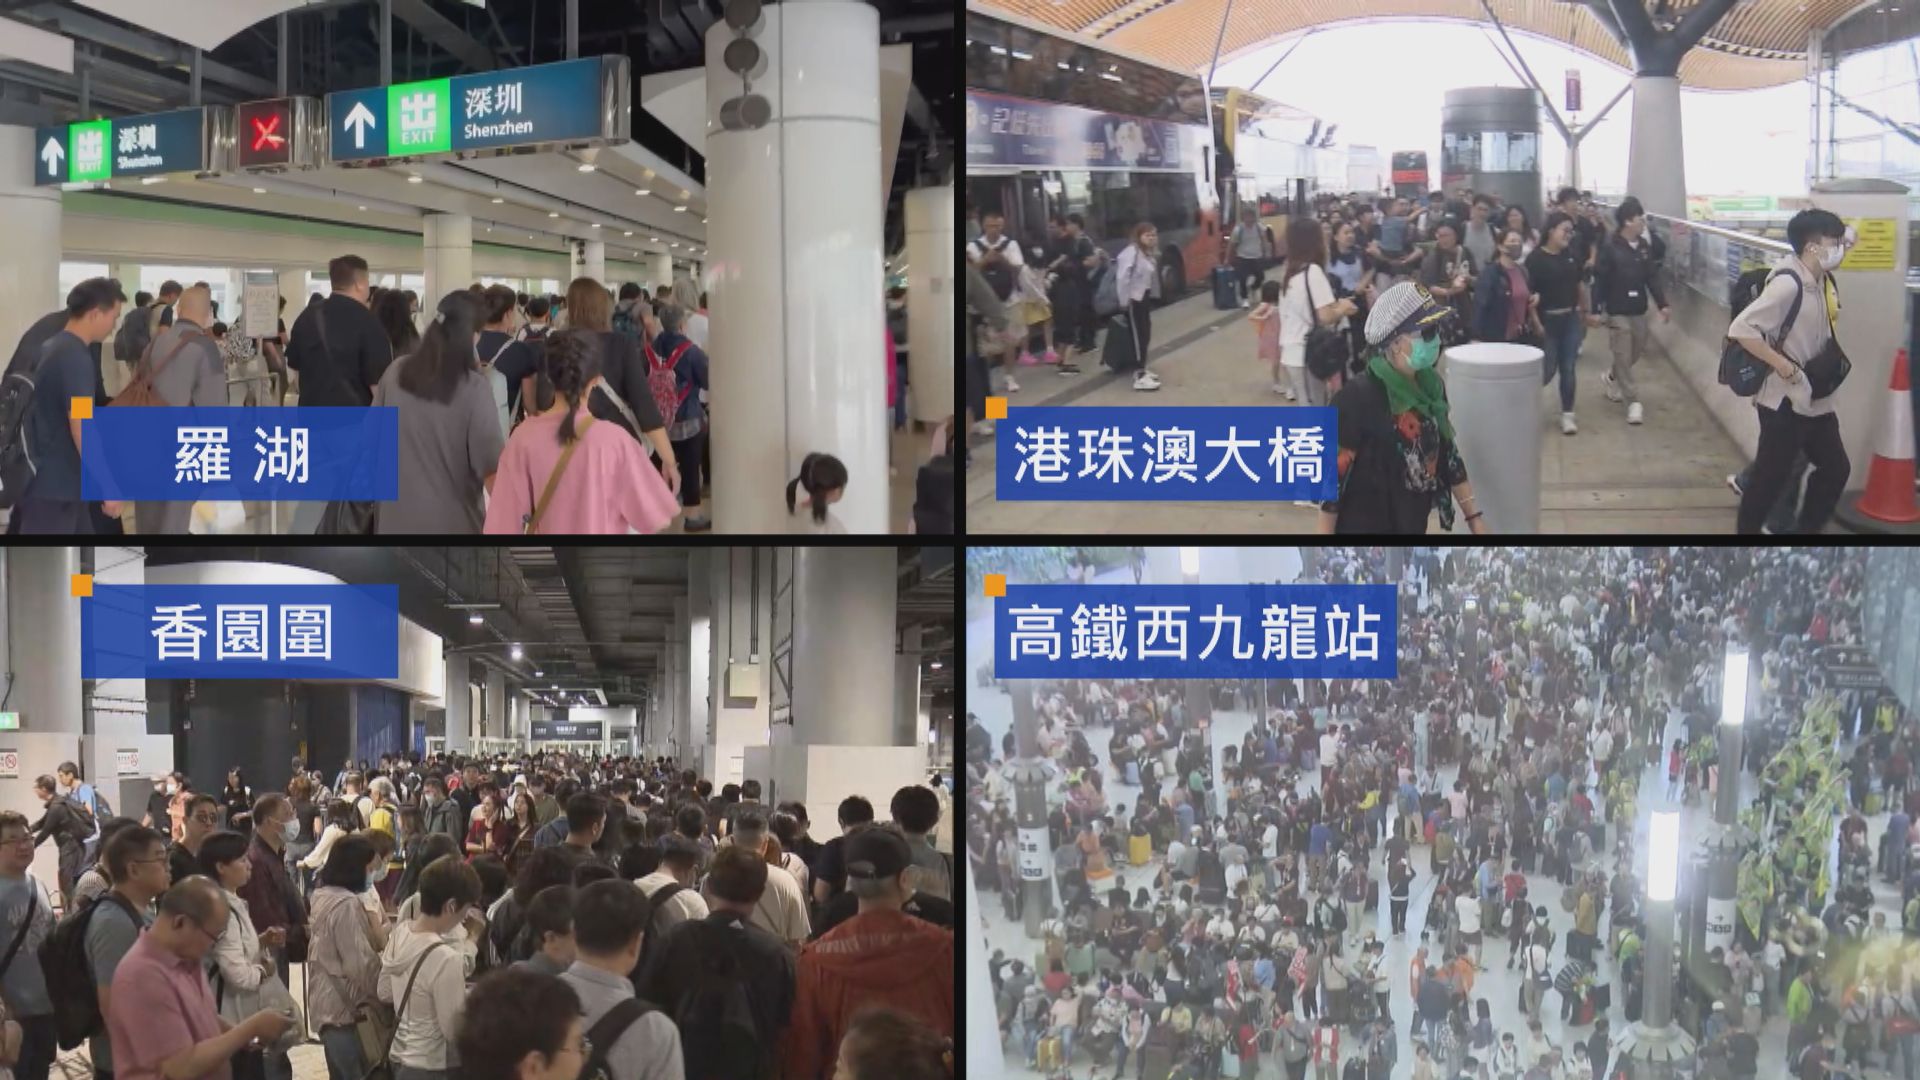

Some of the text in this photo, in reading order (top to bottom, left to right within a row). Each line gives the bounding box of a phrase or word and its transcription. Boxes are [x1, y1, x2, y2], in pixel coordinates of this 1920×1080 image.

[401, 91, 437, 131] 出
[464, 82, 523, 120] 深圳
[401, 129, 436, 145] EXIT
[464, 119, 534, 140] Shenzhen
